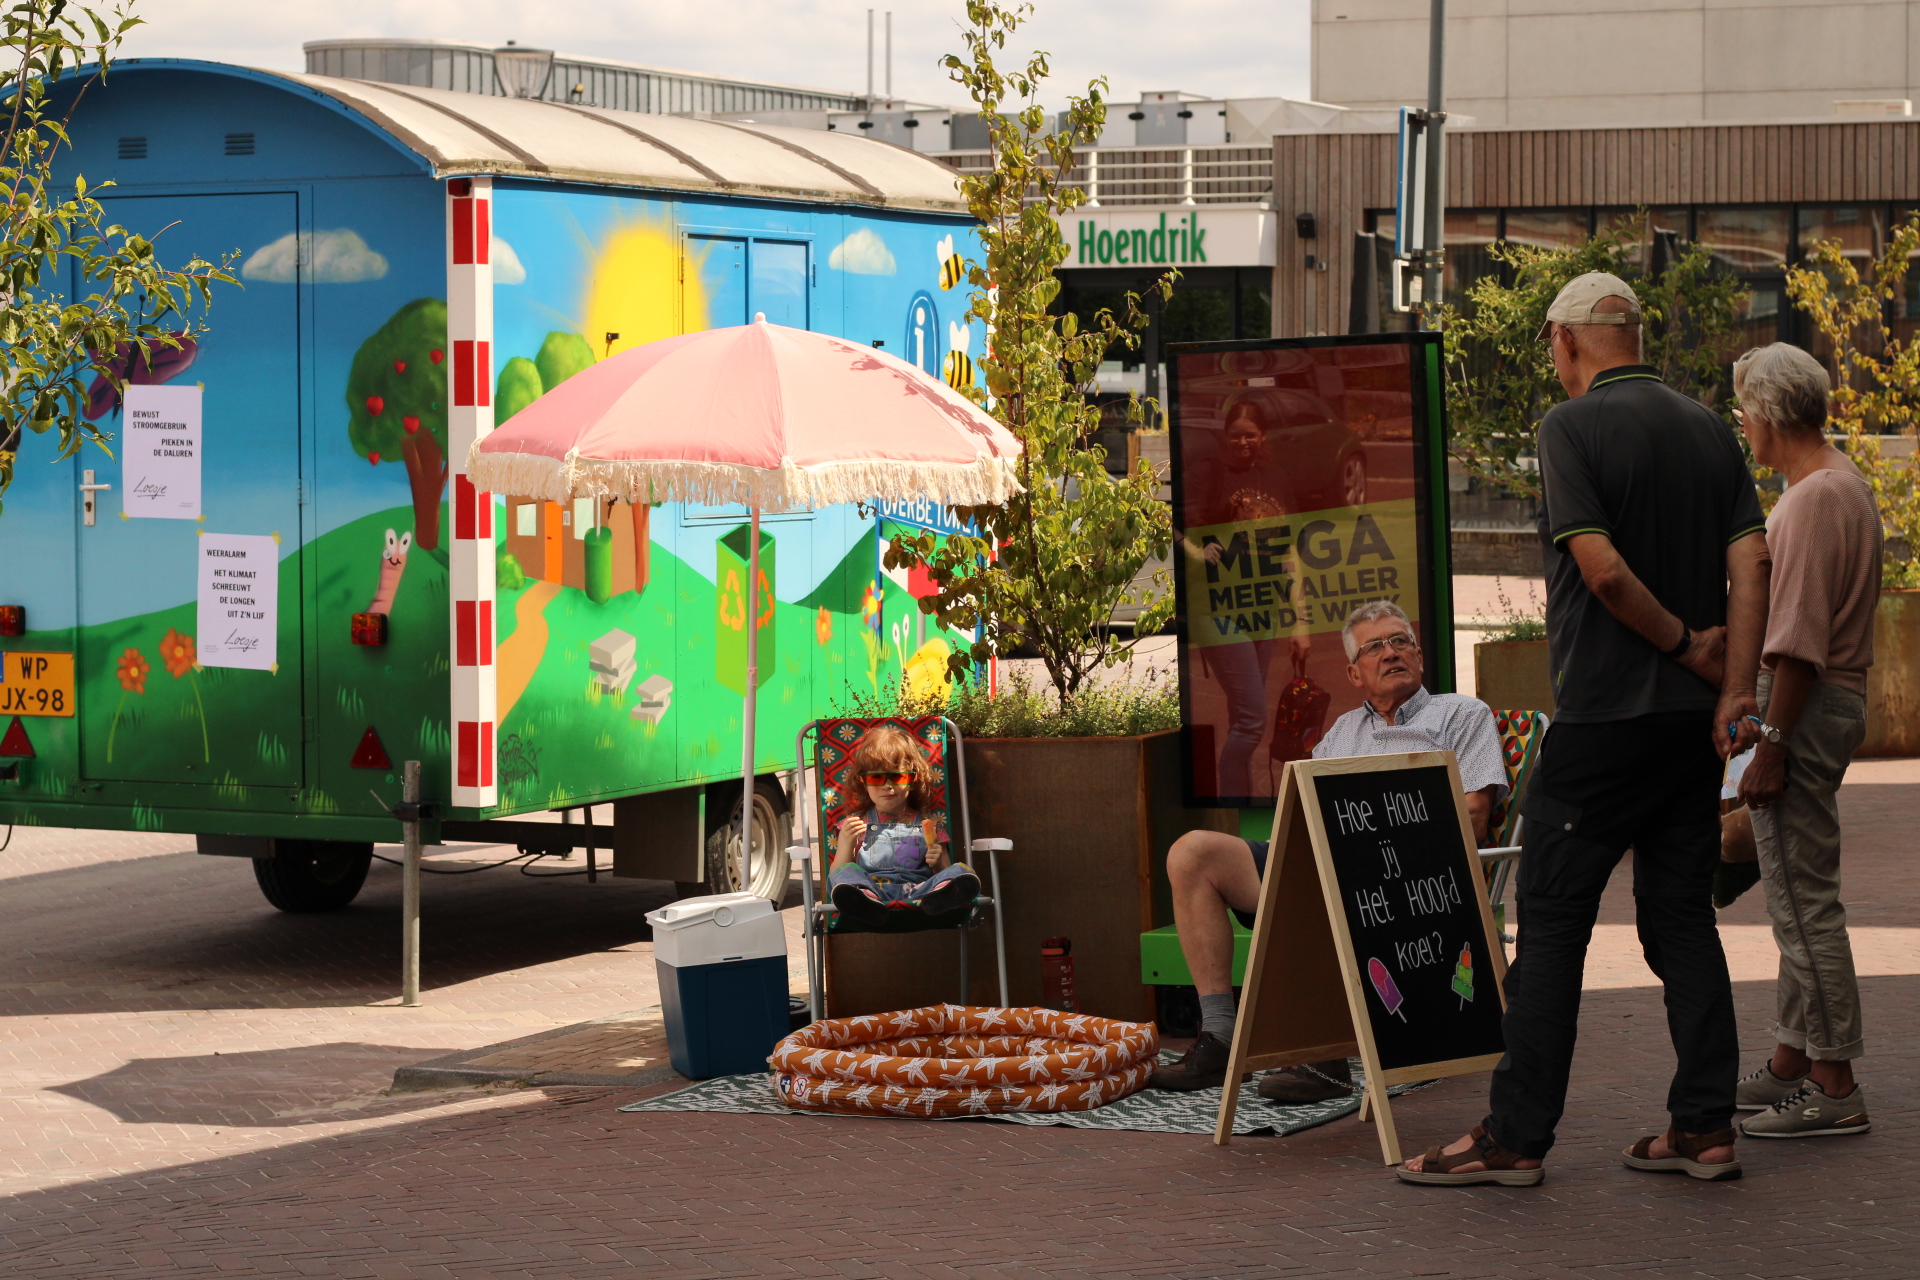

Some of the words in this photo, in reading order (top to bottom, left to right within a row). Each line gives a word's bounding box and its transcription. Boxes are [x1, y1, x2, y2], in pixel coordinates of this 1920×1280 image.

[1079, 212, 1206, 264] Hoendrik
[133, 422, 187, 430] STROOMGEBRUIK
[164, 449, 193, 457] DALUREN
[186, 439, 193, 447] IN
[133, 476, 167, 500] Loesje
[207, 549, 246, 558] WEERALARM
[1202, 514, 1395, 583] MEGA
[229, 570, 256, 578] KLIMAAT
[212, 583, 251, 591] SCHREEUWT
[1209, 566, 1399, 612] MEEVALLER
[230, 597, 255, 605] LONGEN
[227, 610, 238, 618] UIT
[240, 611, 251, 619] Z'N
[1213, 610, 1272, 636] VAN
[1278, 605, 1315, 629] DE
[1321, 594, 1401, 623] WE
[224, 628, 258, 652] Loesje
[20, 657, 48, 679] WP
[2, 688, 64, 711] JX-98
[1335, 799, 1377, 835] Hoe
[1384, 790, 1429, 827] Houd
[1379, 840, 1401, 879] jij
[1356, 886, 1395, 927] Het
[1405, 867, 1462, 916] Hoofd
